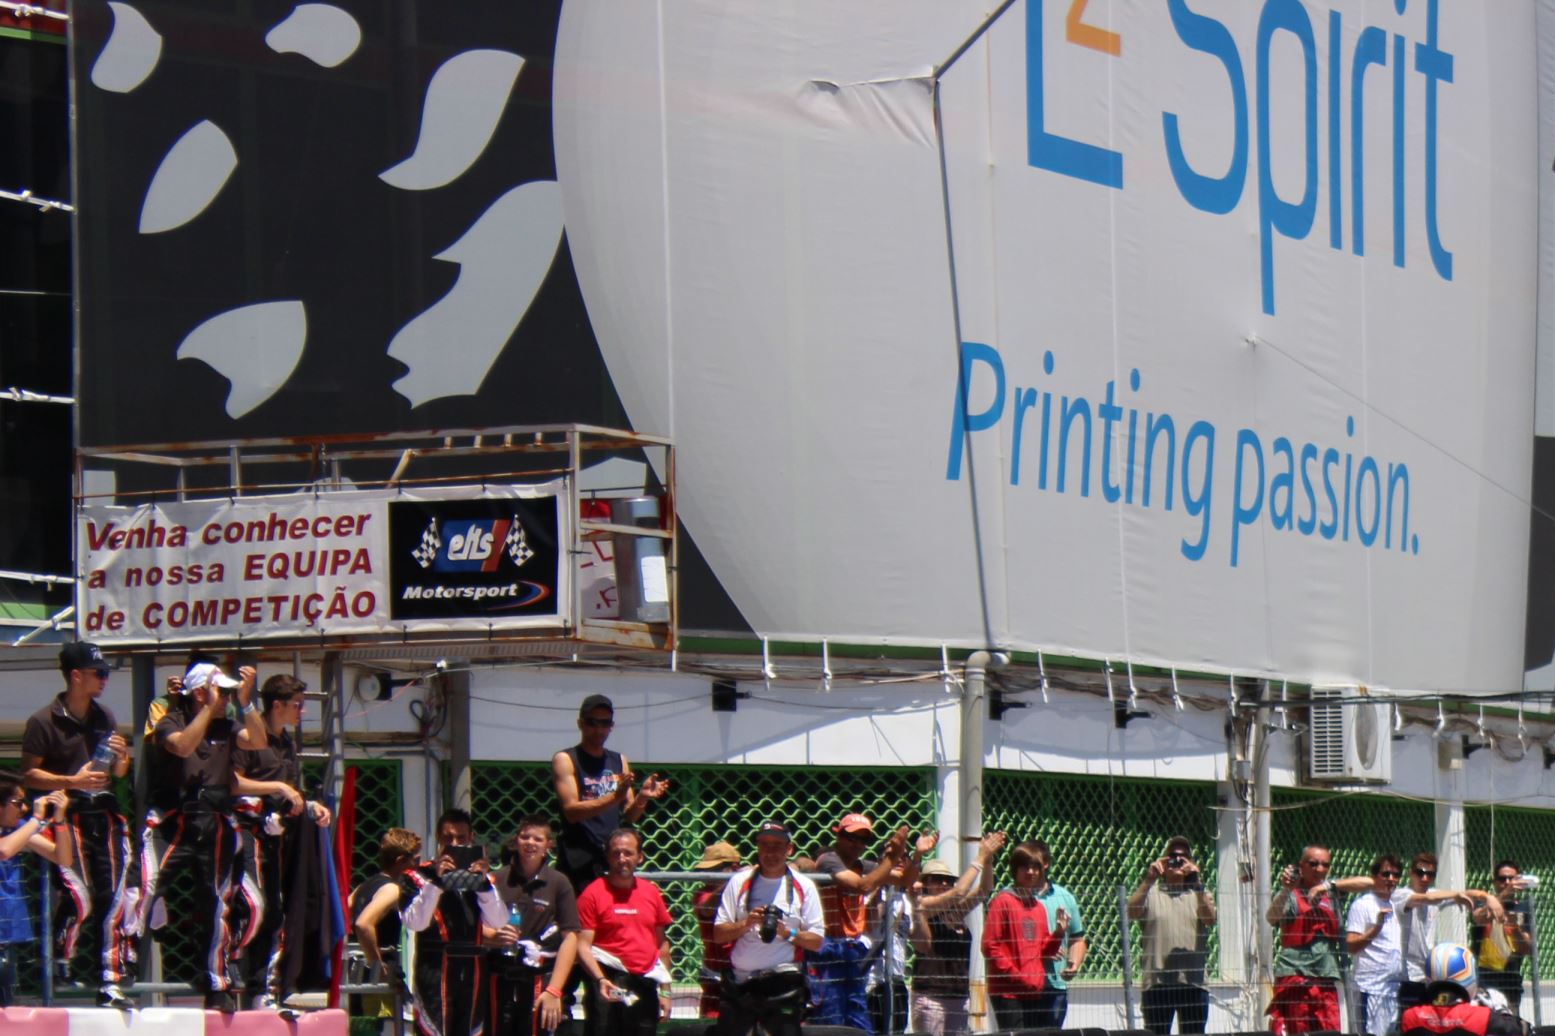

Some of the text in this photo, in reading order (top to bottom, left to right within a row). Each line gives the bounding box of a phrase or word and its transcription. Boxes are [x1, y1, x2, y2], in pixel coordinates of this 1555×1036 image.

[946, 341, 1420, 568] Printing passion.
[86, 512, 372, 551] Venha conhecer
[88, 548, 373, 589] a nossa EQUIPA
[85, 585, 376, 631] de COMPETIÇÃO
[402, 583, 519, 600] Motorsport
